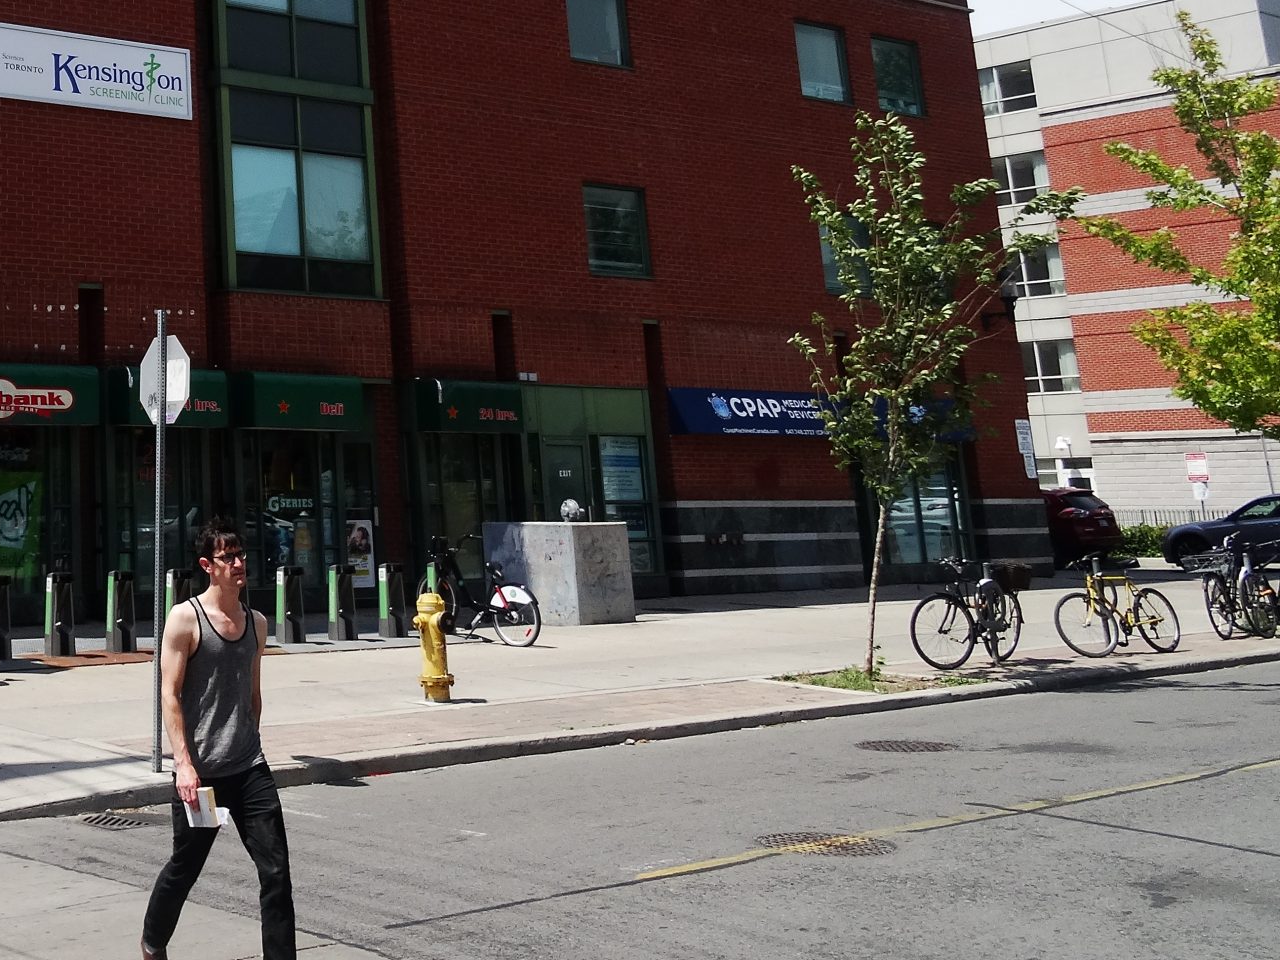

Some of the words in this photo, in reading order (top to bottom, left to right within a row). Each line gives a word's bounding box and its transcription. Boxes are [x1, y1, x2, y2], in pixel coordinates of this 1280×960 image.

[2, 53, 25, 61] Sciences
[4, 62, 44, 74] TORONTO
[51, 53, 183, 95] Kensington
[89, 86, 145, 102] SCREENING
[154, 94, 184, 107] CLINIC
[195, 399, 222, 412] hrs.
[320, 402, 344, 416] Deli
[729, 397, 782, 418] CPAP
[479, 408, 493, 420] 24
[495, 409, 517, 421] hrs.
[268, 496, 280, 512] G
[280, 498, 314, 508] SERIES
